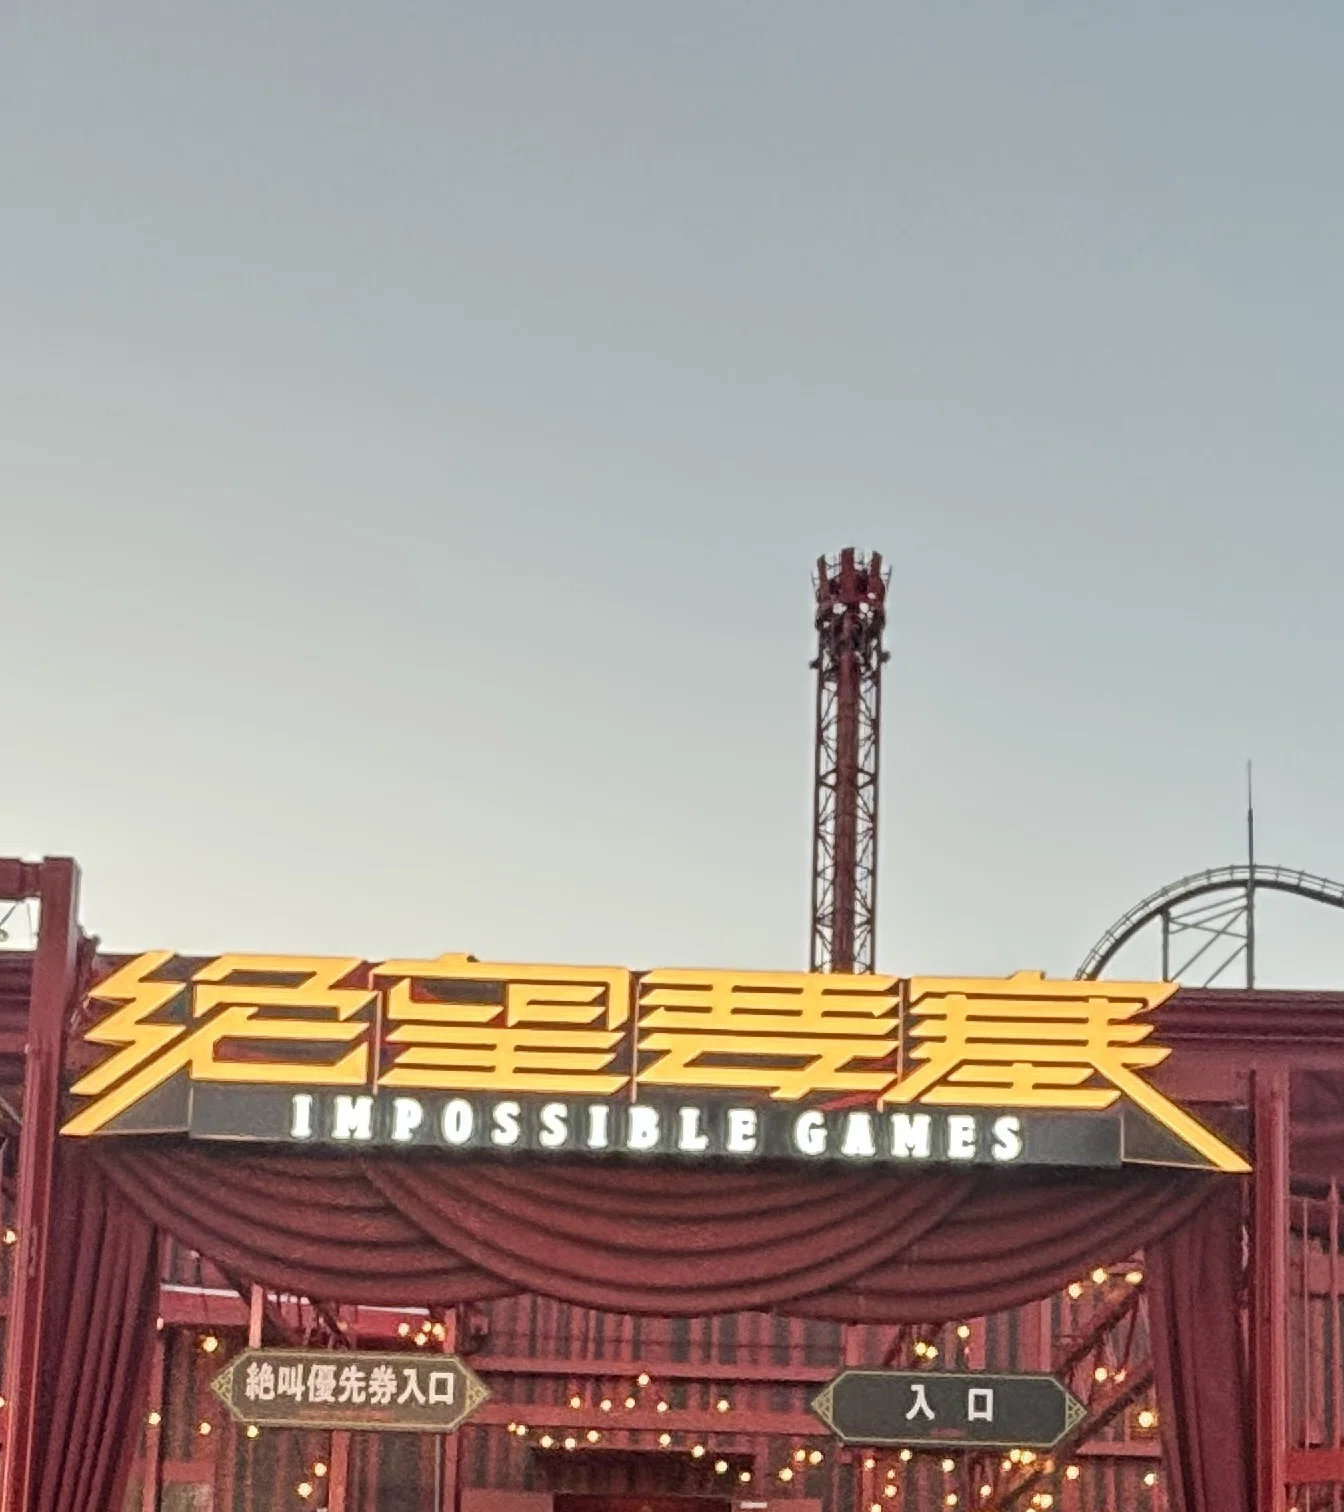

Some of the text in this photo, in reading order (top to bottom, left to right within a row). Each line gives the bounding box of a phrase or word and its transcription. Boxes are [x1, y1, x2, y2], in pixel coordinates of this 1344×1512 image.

[290, 1092, 1023, 1161] IMPOSSIBLE GAMES
[244, 1361, 455, 1406] 絶叫優先券入口
